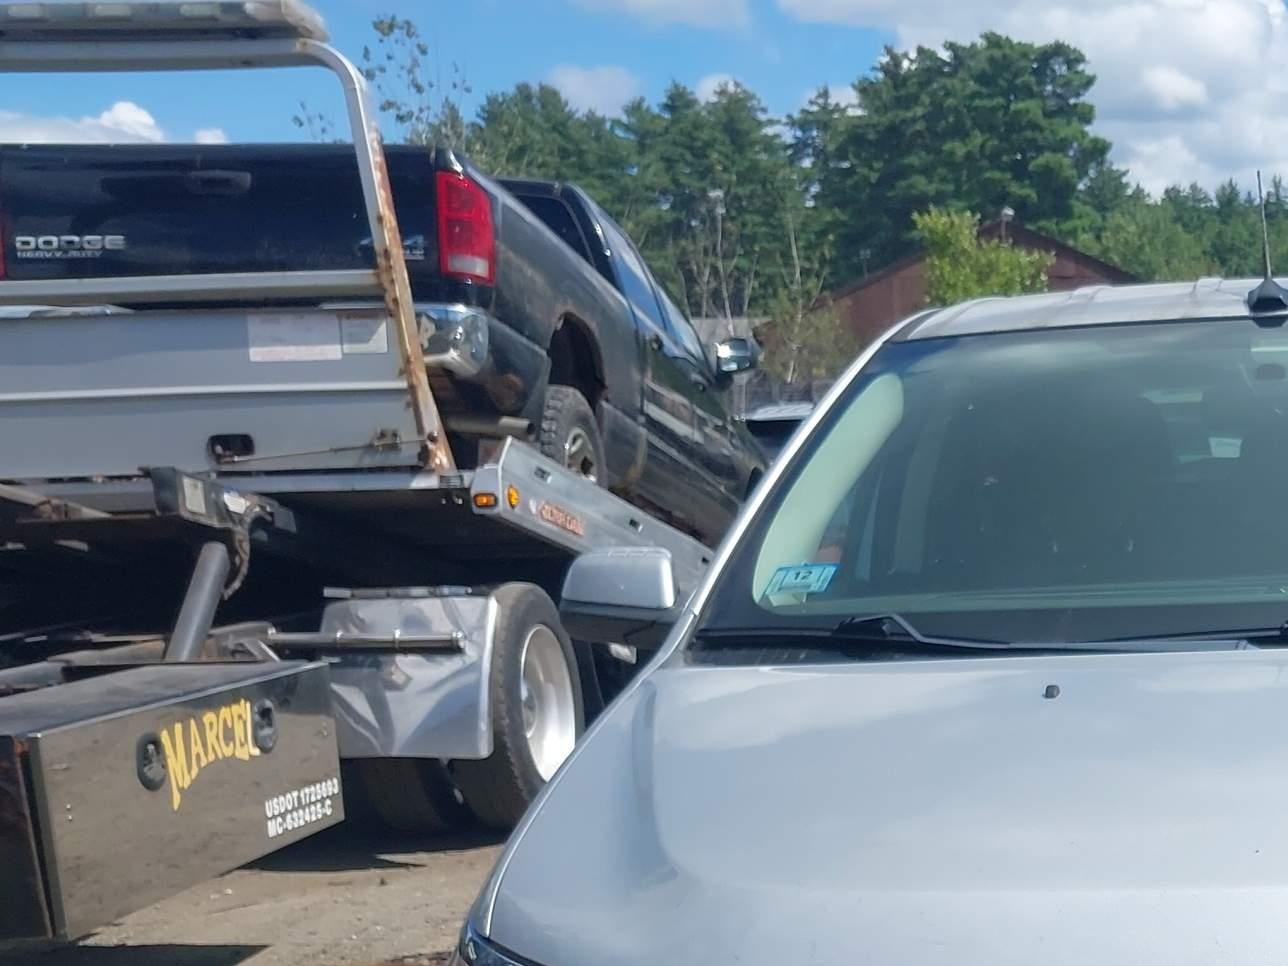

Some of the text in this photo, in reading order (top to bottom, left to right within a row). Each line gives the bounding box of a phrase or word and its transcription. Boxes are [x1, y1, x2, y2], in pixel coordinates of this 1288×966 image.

[15, 235, 126, 250] DODGE
[160, 697, 261, 811] MARCEL
[265, 790, 299, 818] USDOT
